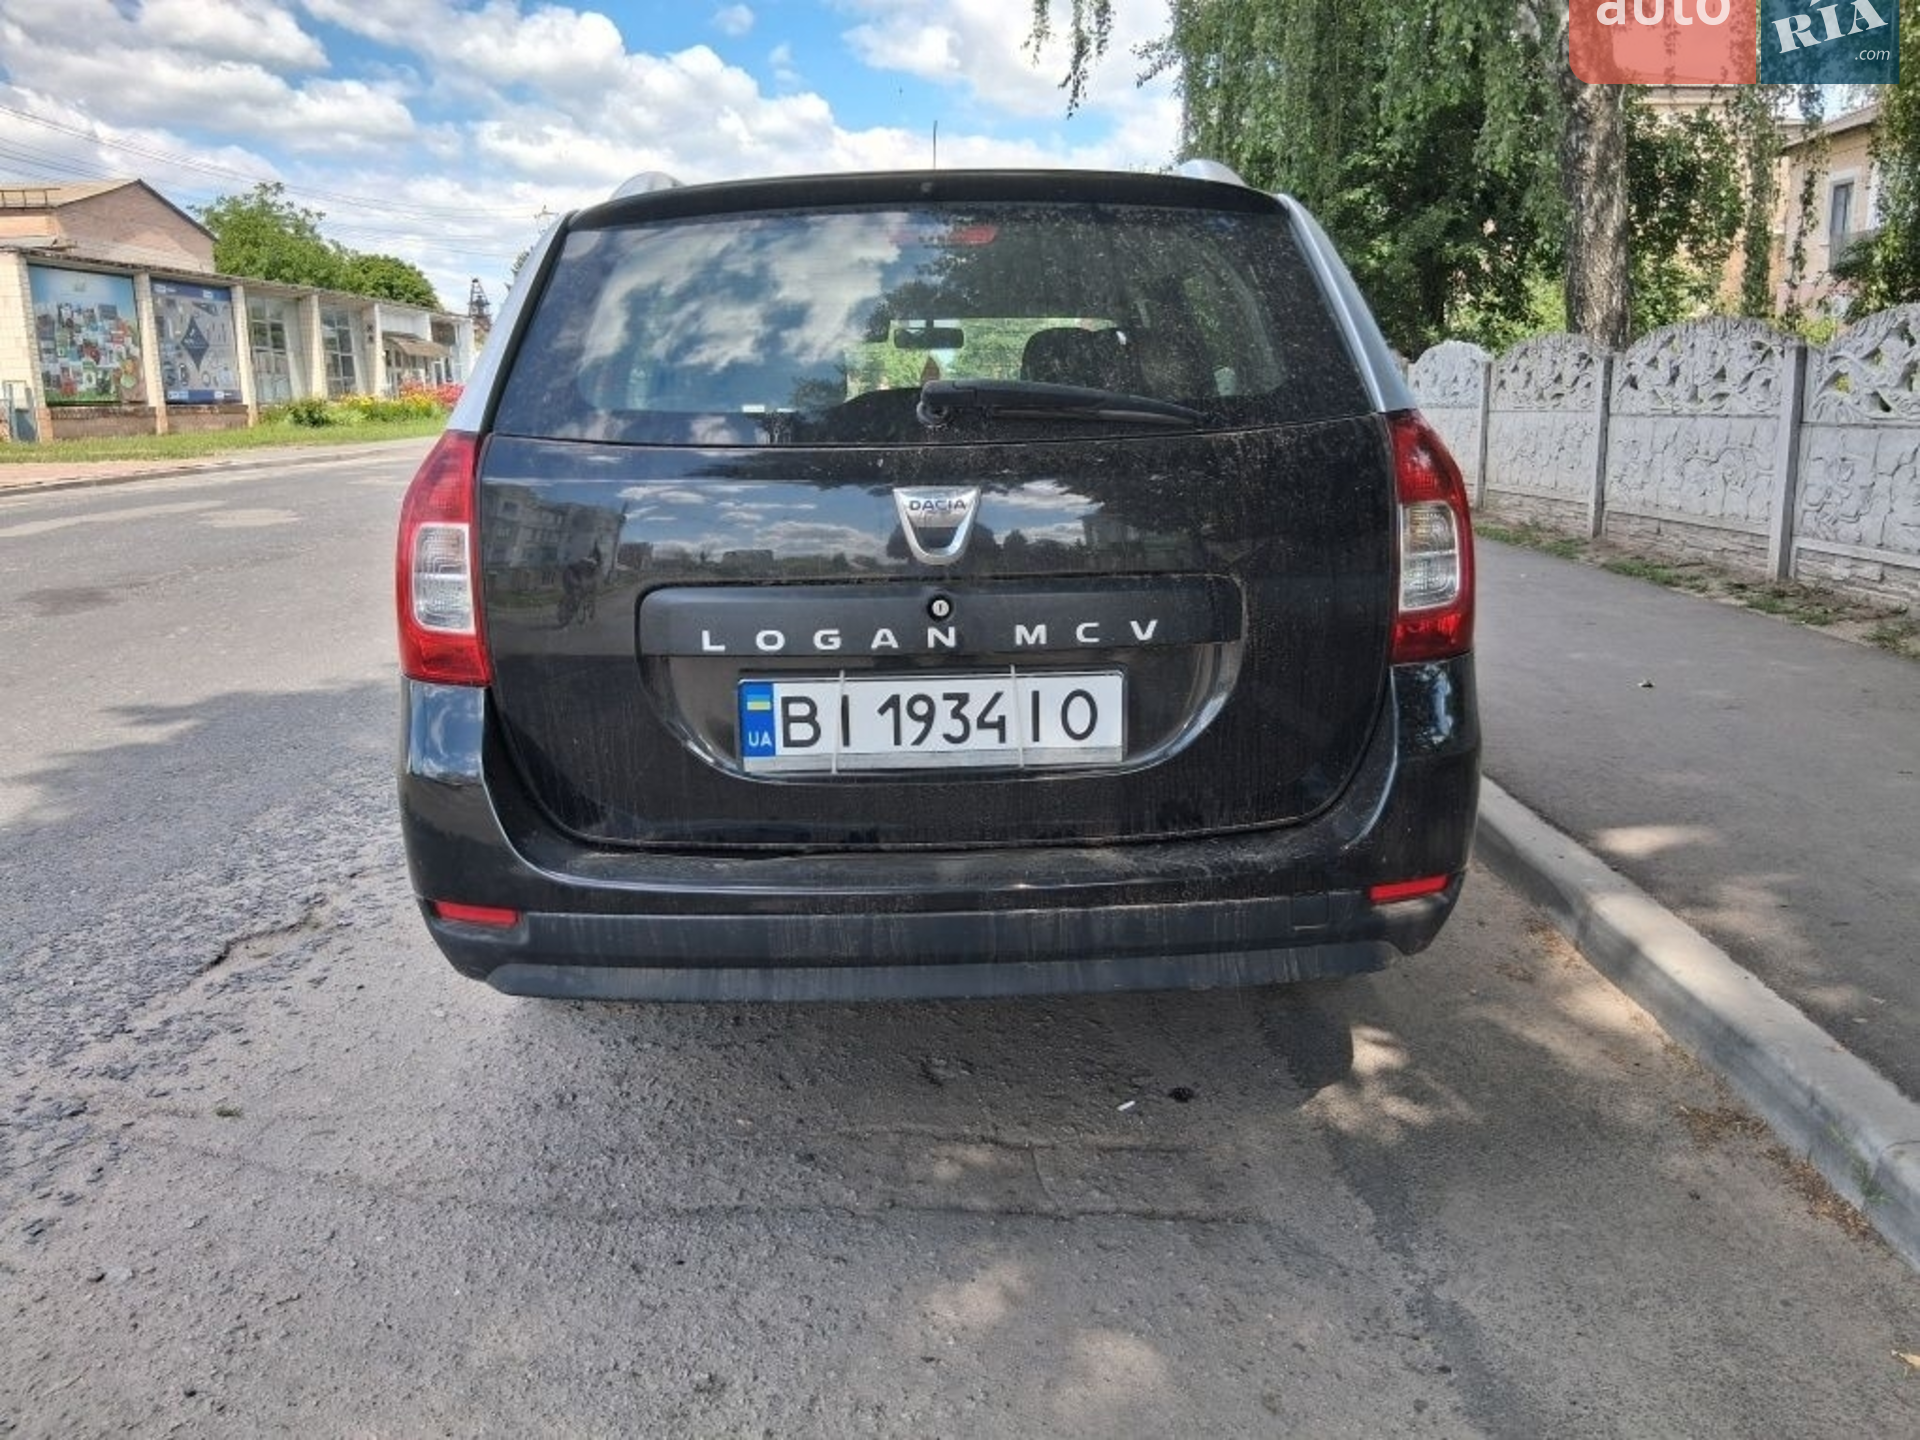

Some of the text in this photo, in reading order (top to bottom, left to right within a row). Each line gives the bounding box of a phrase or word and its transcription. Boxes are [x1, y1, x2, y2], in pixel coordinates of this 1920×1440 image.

[909, 500, 967, 511] DACIA
[701, 619, 1158, 652] LOGAN MCV
[780, 694, 850, 748] BI
[748, 730, 773, 747] UA
